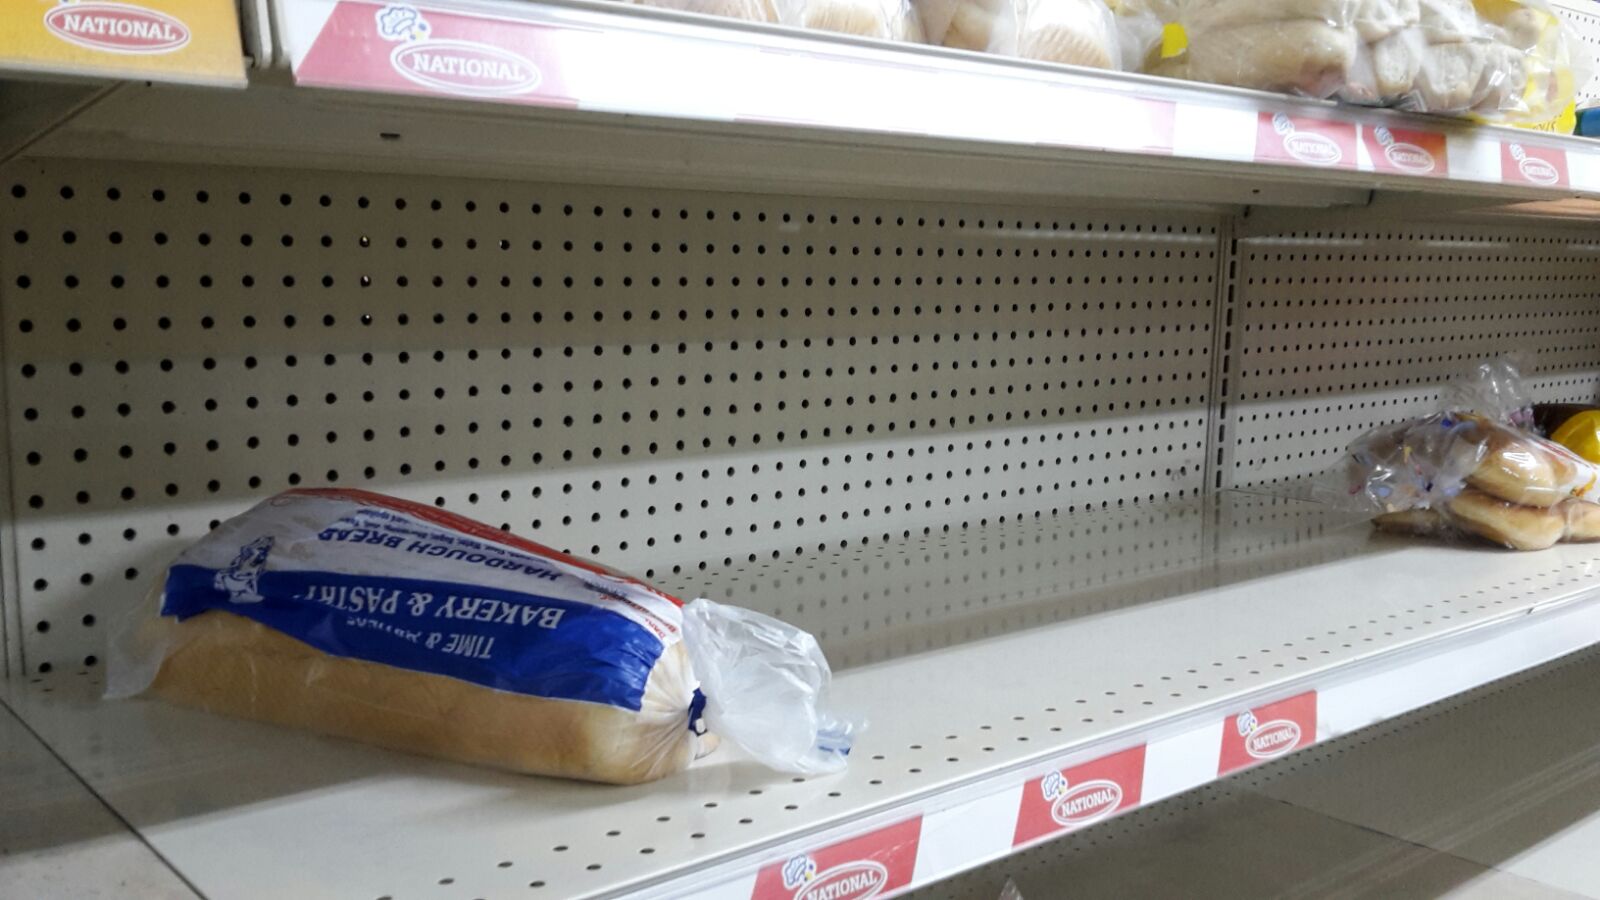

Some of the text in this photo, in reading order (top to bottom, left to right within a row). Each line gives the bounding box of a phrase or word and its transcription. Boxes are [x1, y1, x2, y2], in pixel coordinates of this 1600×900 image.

[63, 14, 177, 42] NATIONAL
[411, 51, 527, 84] NATIONAL
[316, 527, 406, 551] BREAD
[405, 540, 564, 582] HARDOUGH
[406, 592, 434, 617] &
[434, 595, 566, 630] BAKERY
[425, 631, 496, 660] TIME &
[1251, 725, 1296, 752] NATIONAL
[1060, 787, 1116, 818] NATIONAL
[806, 869, 879, 900] NATIONAL
